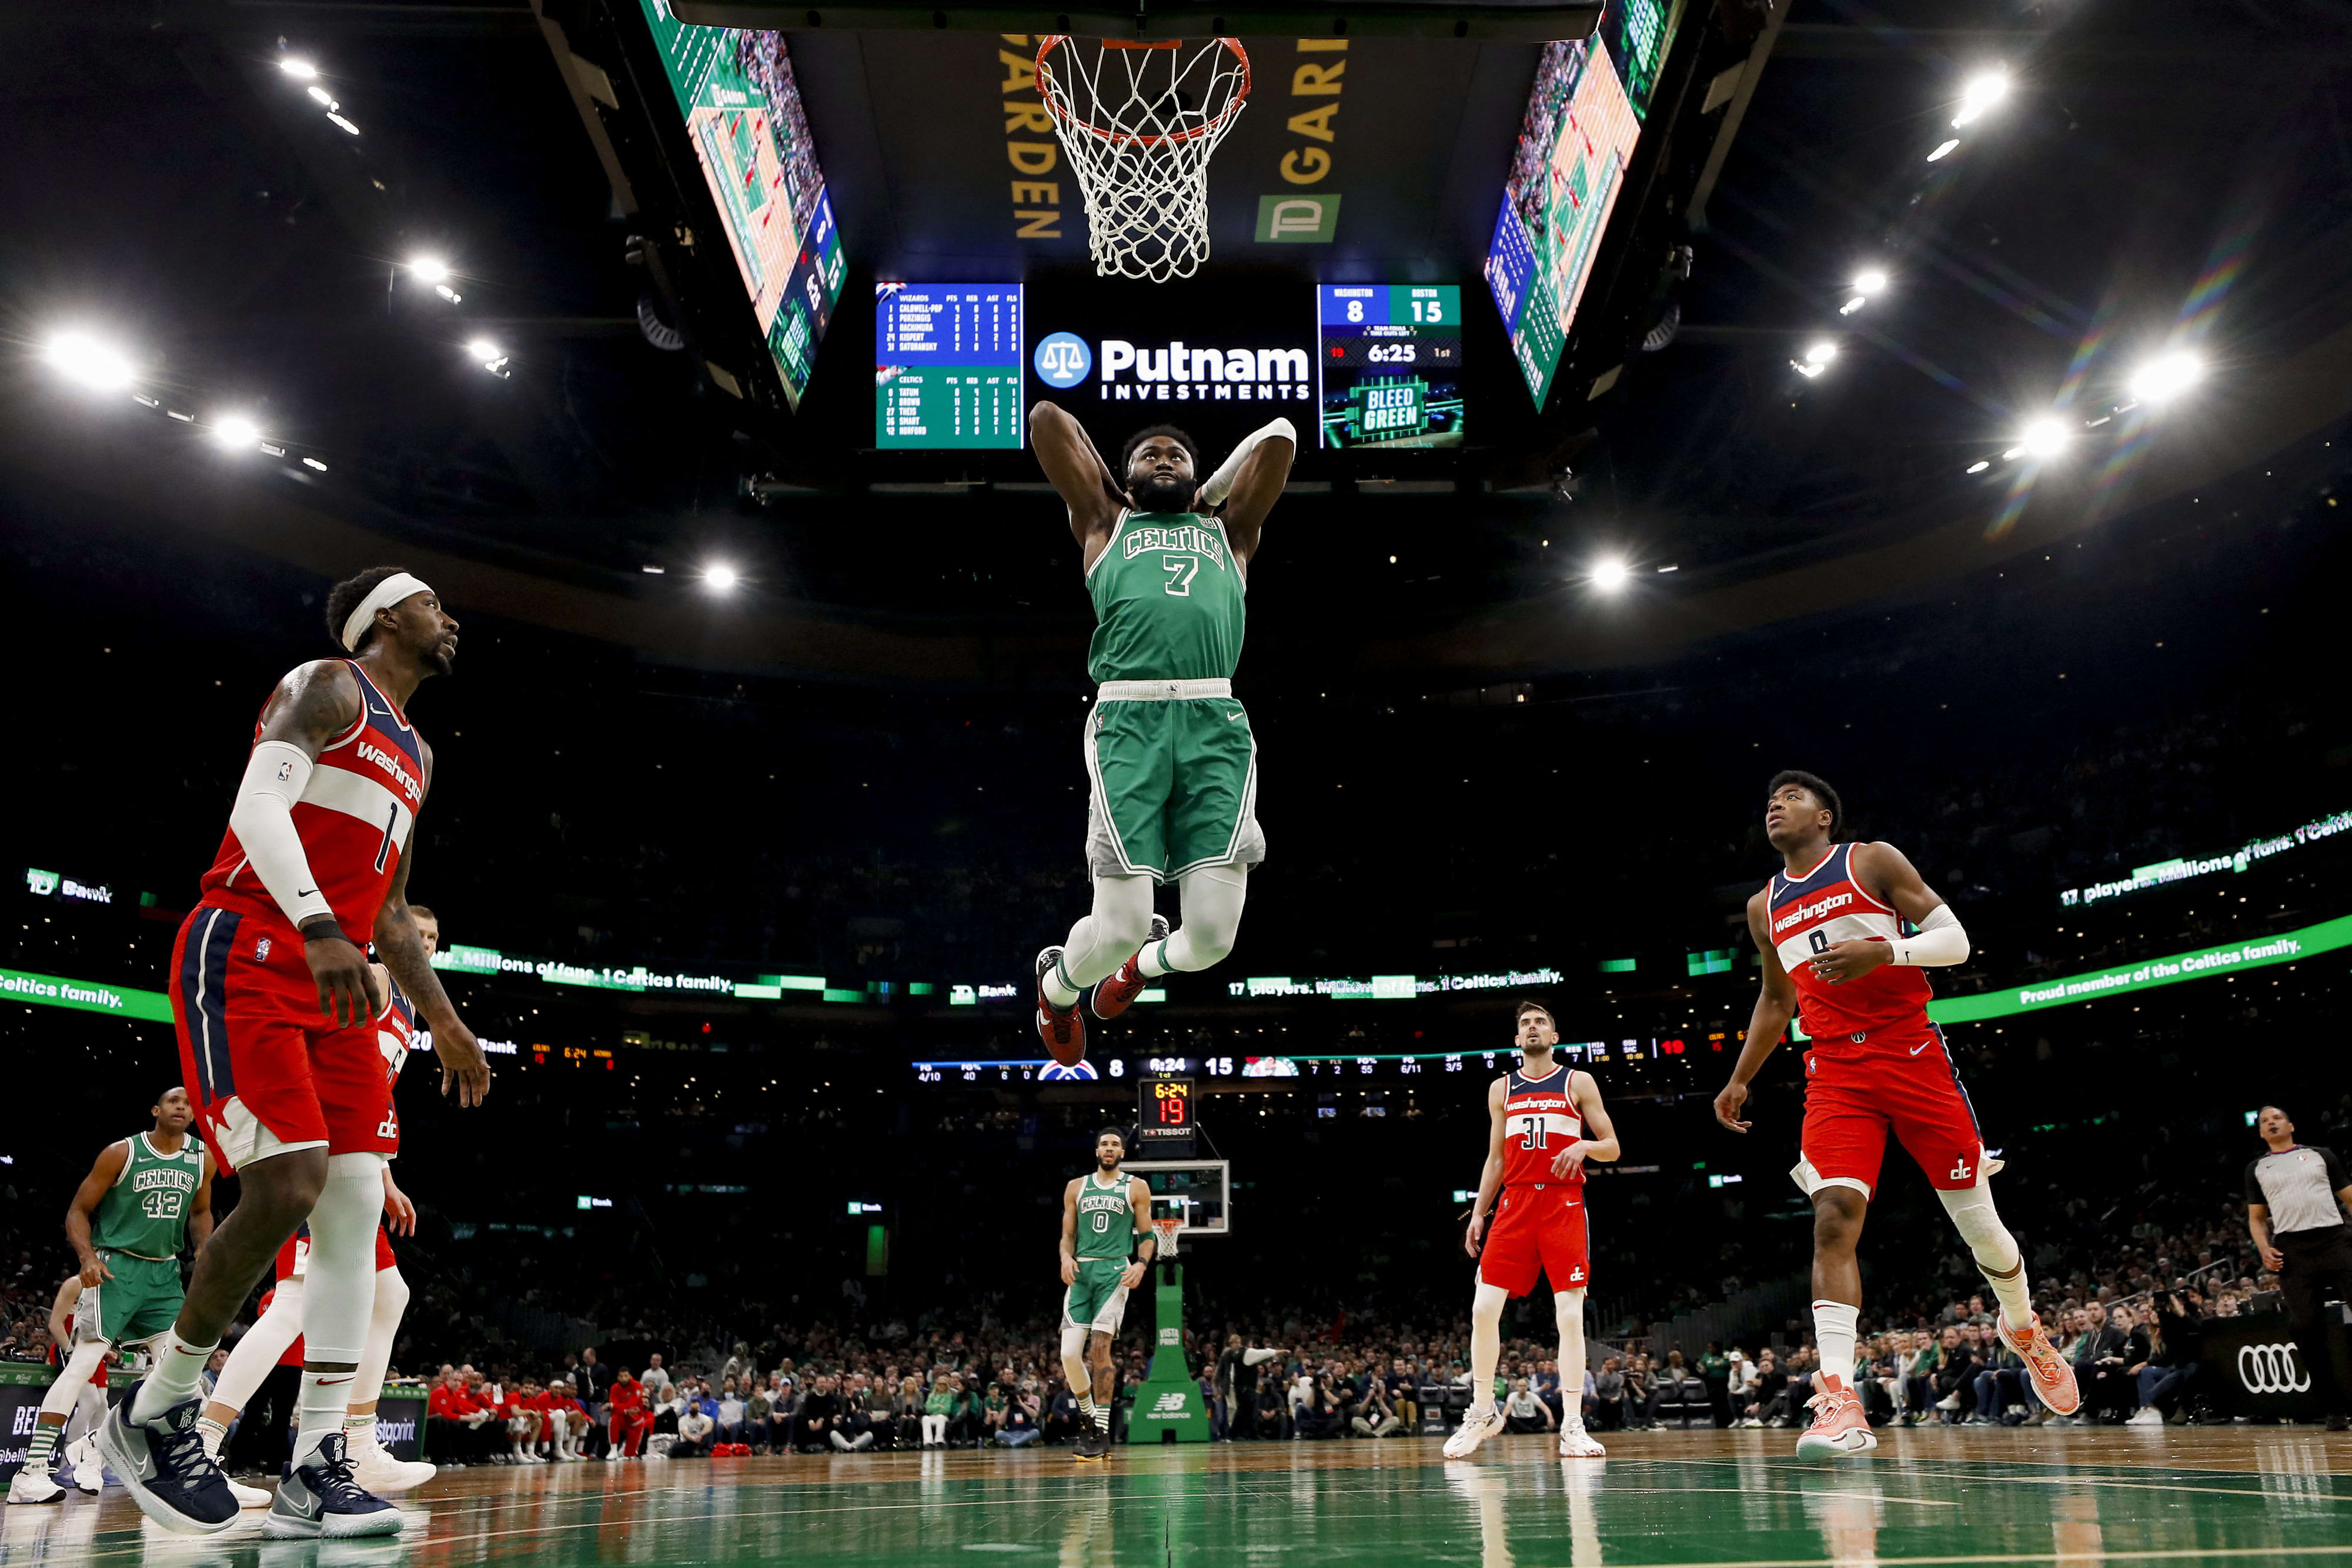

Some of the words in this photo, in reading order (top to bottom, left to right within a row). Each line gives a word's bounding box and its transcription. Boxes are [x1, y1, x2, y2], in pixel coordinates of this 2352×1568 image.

[1334, 289, 1373, 297] WASHINGTON
[1412, 289, 1437, 297] BOSTON
[1347, 300, 1364, 322] 8
[1411, 301, 1442, 322] 15
[1101, 340, 1308, 382] Putnam
[1368, 344, 1416, 362] 6:25
[1434, 348, 1450, 357] 1st
[899, 388, 918, 396] TATUM
[1101, 385, 1309, 400] INVESTMENTS
[1368, 387, 1414, 410] BLEED
[886, 407, 894, 416] 27
[899, 407, 916, 416] THEIS
[899, 417, 920, 425] SMART
[1364, 405, 1417, 432] GREEN
[899, 426, 926, 434] HORFORD
[1122, 526, 1225, 571] CELTICS
[1163, 555, 1198, 597] 7
[375, 801, 397, 875] 1
[2060, 888, 2079, 906] 17
[2159, 855, 2233, 883] Millions
[62, 880, 112, 904] Bank
[1775, 892, 1853, 934] washington
[463, 952, 533, 974] Millions
[536, 962, 554, 975] of
[613, 969, 673, 988] Celtics
[676, 974, 734, 994] family.
[2020, 984, 2065, 1004] Proud
[2067, 972, 2130, 997] member
[2134, 965, 2150, 982] of
[2153, 962, 2179, 977] the
[2181, 952, 2241, 973] Celtics
[2243, 938, 2300, 961] family.
[0, 974, 57, 998] eltics
[61, 984, 123, 1008] family.
[978, 984, 1017, 998] Bank
[1228, 982, 1245, 995] 17
[1250, 982, 1314, 997] players.
[1451, 974, 1508, 991] Celtics
[1508, 968, 1564, 986] family.
[564, 1047, 586, 1058] 6:24
[1661, 1039, 1685, 1054] 19
[1110, 1059, 1124, 1076] 8
[1150, 1058, 1185, 1072] 6:24
[1205, 1058, 1232, 1075] 15
[1312, 1066, 1318, 1075] 7
[1334, 1066, 1341, 1075] 2
[1361, 1065, 1373, 1074] 55
[1401, 1064, 1421, 1074] 6/11
[1445, 1062, 1462, 1072] 3/5
[1486, 1060, 1494, 1069] 0
[1572, 1054, 1578, 1062] 7
[918, 1072, 941, 1082] 4/10
[963, 1072, 975, 1081] 40
[1001, 1071, 1008, 1080] 6
[1023, 1071, 1030, 1079] 0
[1155, 1083, 1188, 1099] 6:24
[1160, 1099, 1184, 1124] 19
[1506, 1096, 1566, 1112] washington
[1521, 1117, 1548, 1150] 31
[132, 1168, 194, 1194] CELTICS
[142, 1191, 183, 1219] 42
[1080, 1195, 1125, 1215] CELTICS
[1092, 1211, 1109, 1233] 0
[1160, 1328, 1179, 1338] VISTA
